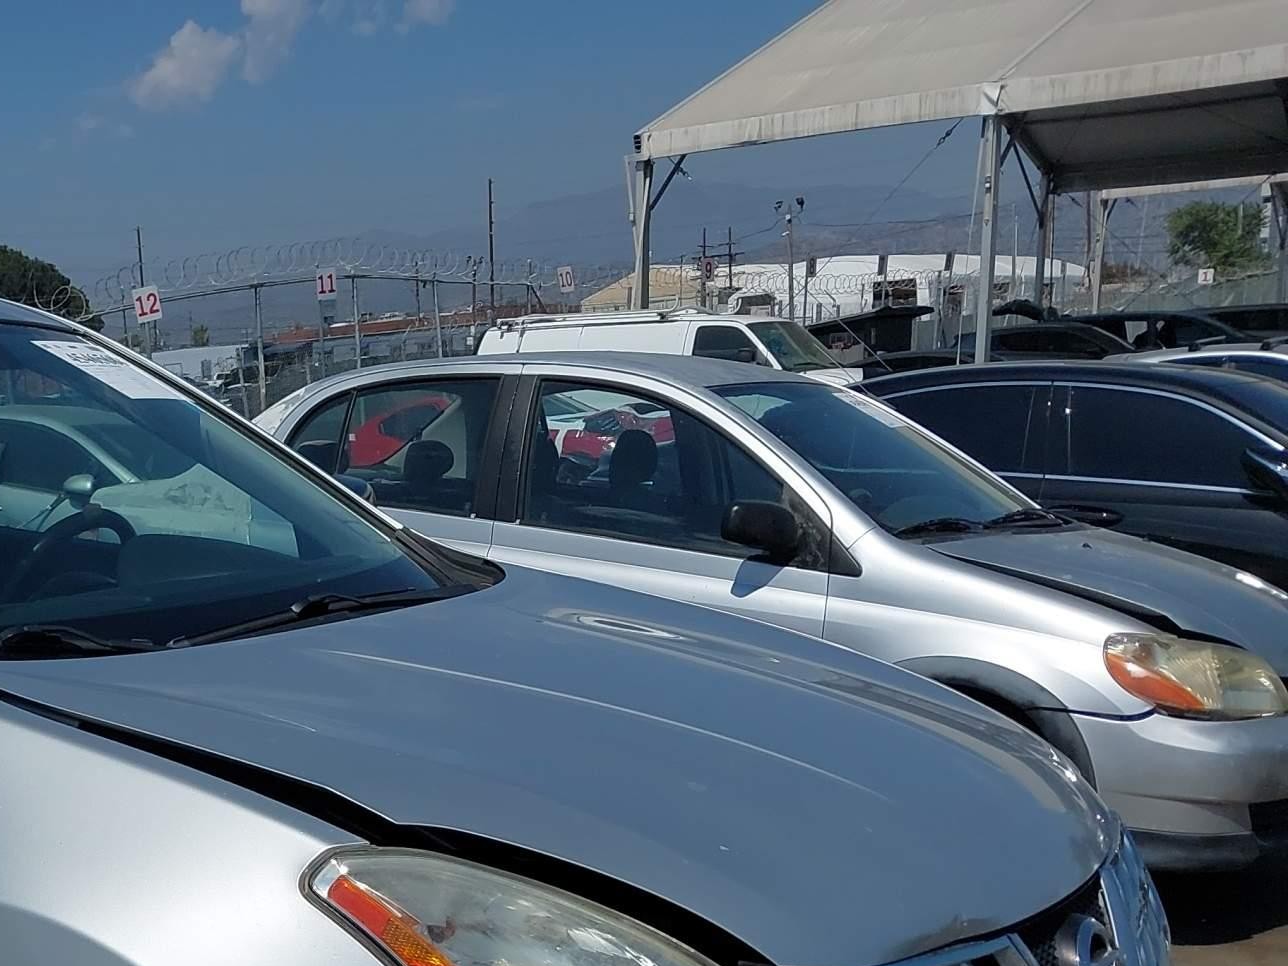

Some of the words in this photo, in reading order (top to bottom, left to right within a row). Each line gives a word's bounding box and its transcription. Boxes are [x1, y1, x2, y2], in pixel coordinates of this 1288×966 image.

[317, 274, 337, 294] 11
[560, 271, 573, 288] 10
[135, 292, 161, 317] 12
